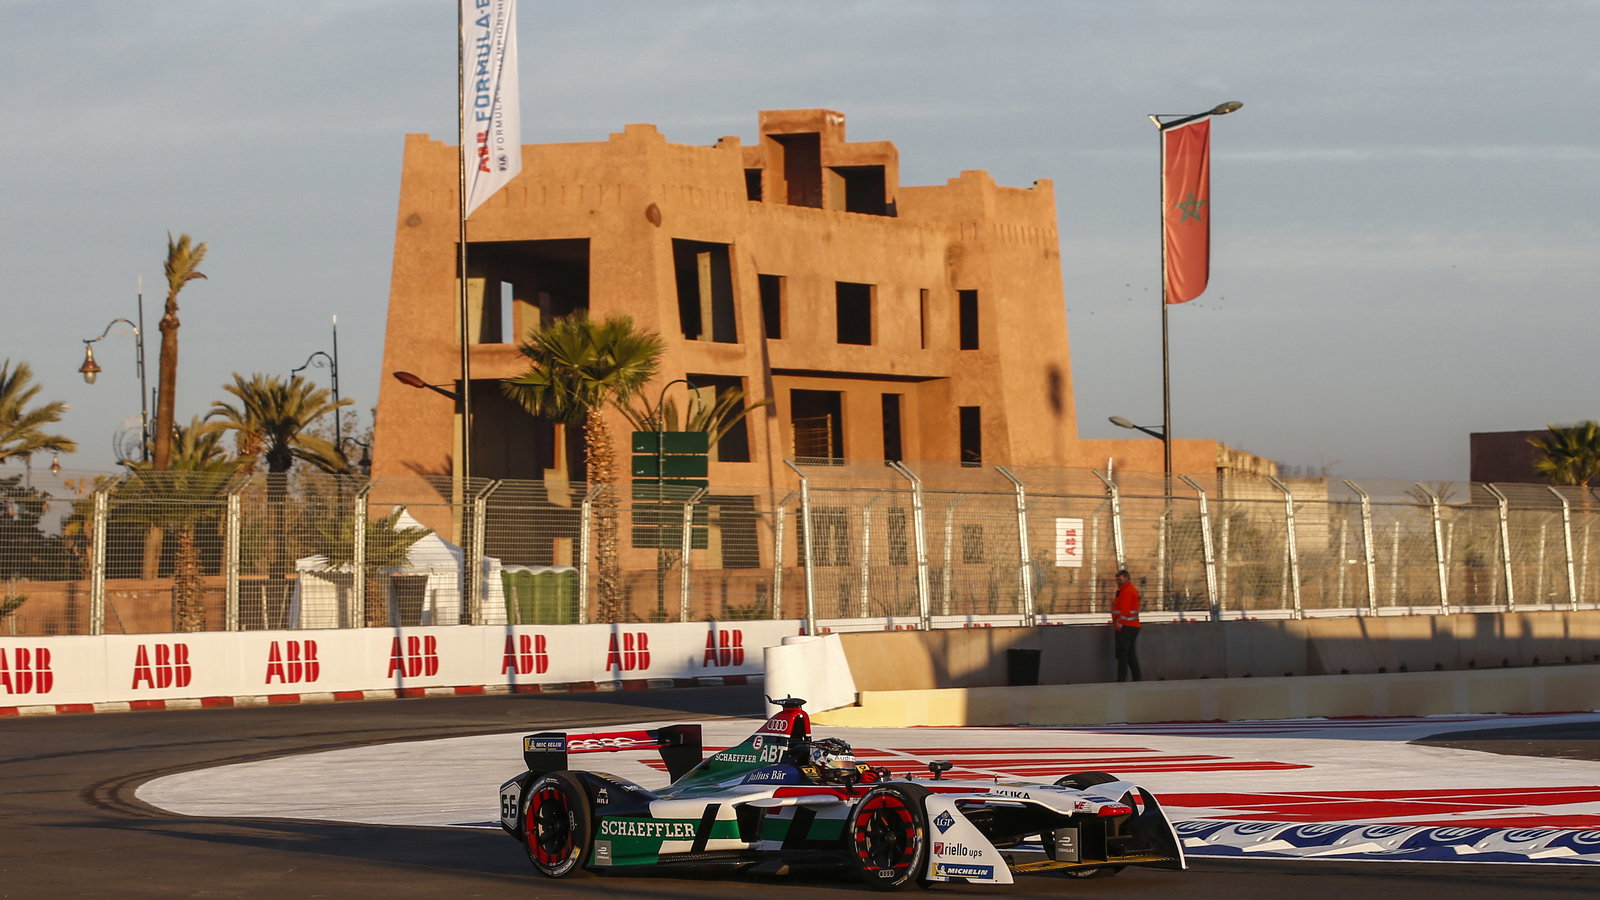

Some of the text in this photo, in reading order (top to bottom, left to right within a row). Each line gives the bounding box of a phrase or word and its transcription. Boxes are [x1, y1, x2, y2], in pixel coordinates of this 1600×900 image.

[476, 130, 491, 173] ABB
[499, 156, 507, 171] FIA
[1065, 529, 1077, 556] ABB
[387, 635, 439, 678] ABB
[501, 634, 549, 675] ABB
[606, 632, 650, 671] ABB
[703, 629, 745, 668] ABB
[131, 643, 192, 689] ABB
[265, 640, 320, 684] ABB
[715, 753, 756, 763] SCHAEFFLER
[760, 745, 788, 763] ABT
[748, 770, 787, 783] Julius Bär
[502, 794, 517, 818] 66
[601, 820, 696, 838] SCHAEFFLER
[936, 818, 952, 826] LGT
[945, 843, 983, 859] riello ups
[947, 867, 988, 876] MICHELIN
